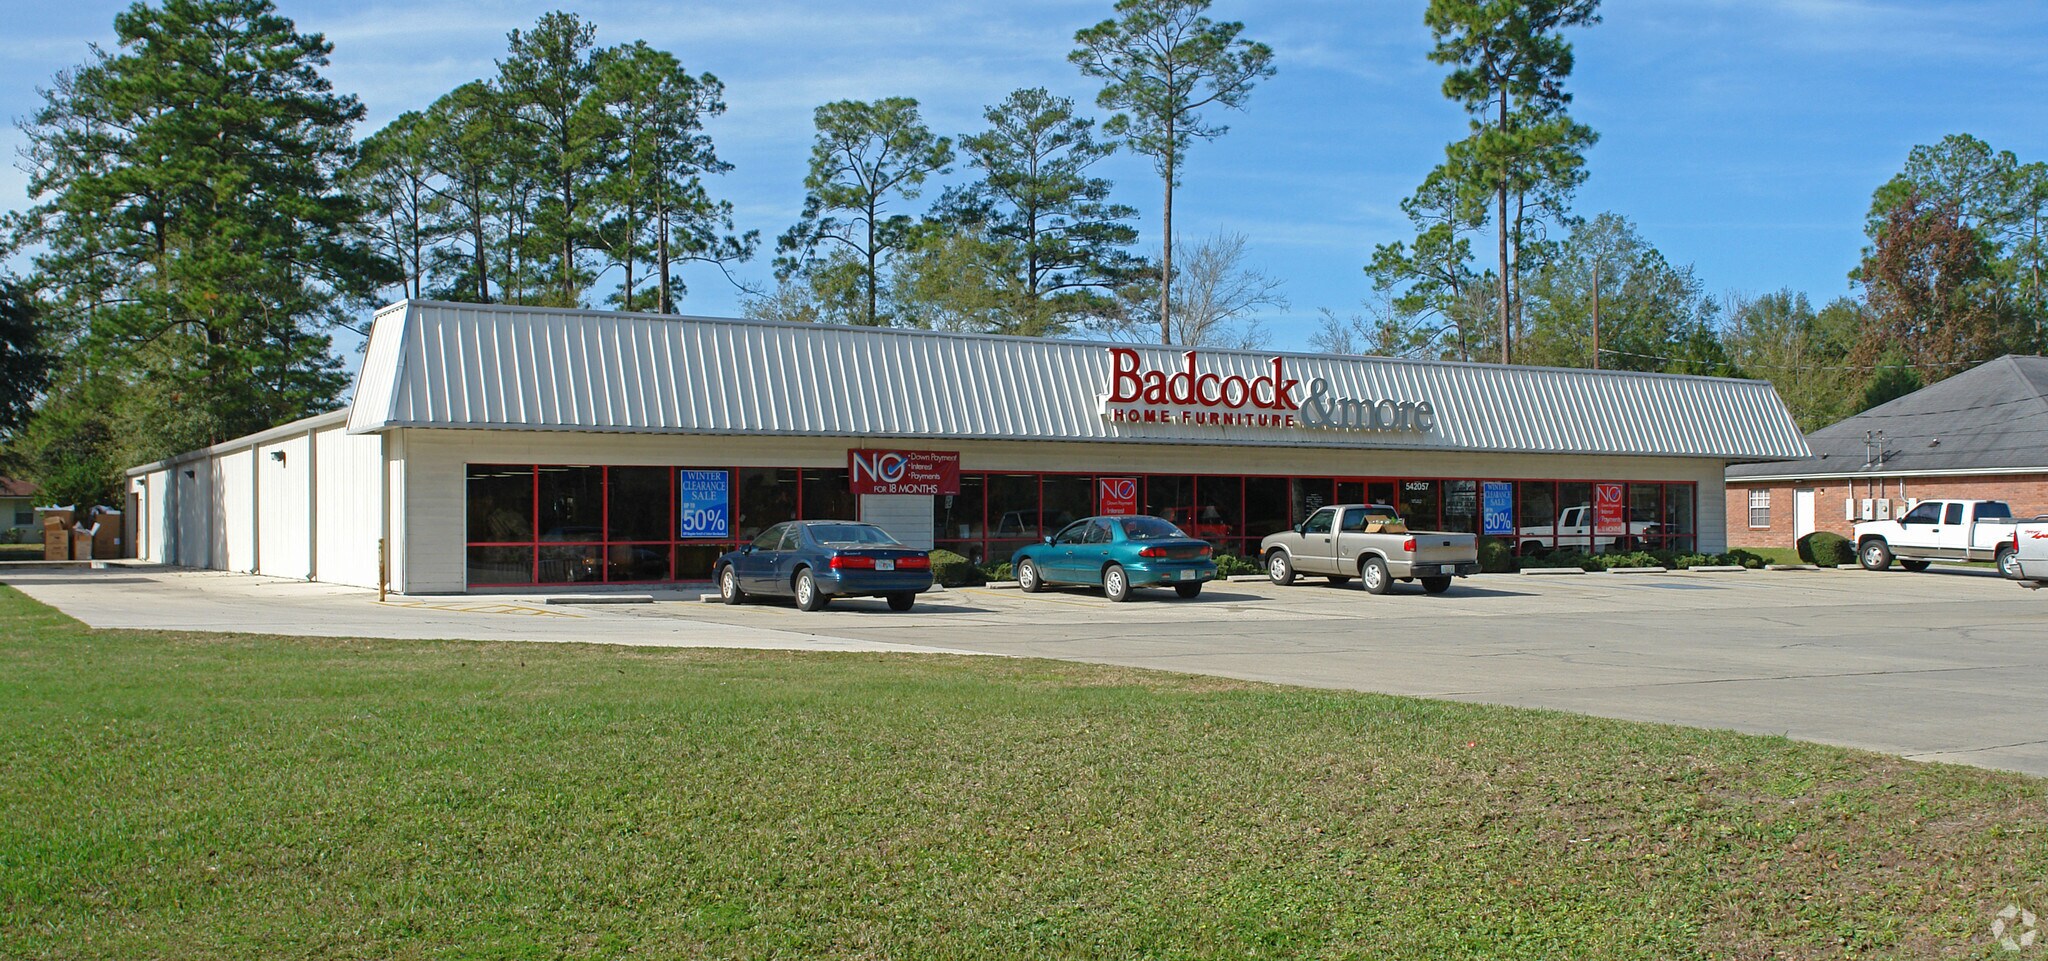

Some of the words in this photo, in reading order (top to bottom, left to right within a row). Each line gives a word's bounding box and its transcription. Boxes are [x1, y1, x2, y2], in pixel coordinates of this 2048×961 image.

[1107, 347, 1300, 411] Badcock
[1114, 408, 1170, 423] HOME
[1182, 410, 1294, 427] FURNITURE
[911, 452, 930, 461] Down
[931, 453, 957, 463] Payment
[853, 452, 906, 483] NO
[911, 462, 932, 470] Interest
[688, 472, 721, 480] WINTER
[911, 471, 940, 481] Payments
[683, 481, 726, 491] CLEARANCE
[873, 485, 887, 493] FOR
[889, 484, 896, 493] 18
[898, 484, 938, 493] MONTHS
[1101, 480, 1135, 500] NO
[1405, 482, 1429, 491] 542057
[692, 491, 717, 500] SALE
[1597, 486, 1621, 502] NO
[683, 509, 725, 531] 50%
[1486, 512, 1511, 529] 50%
